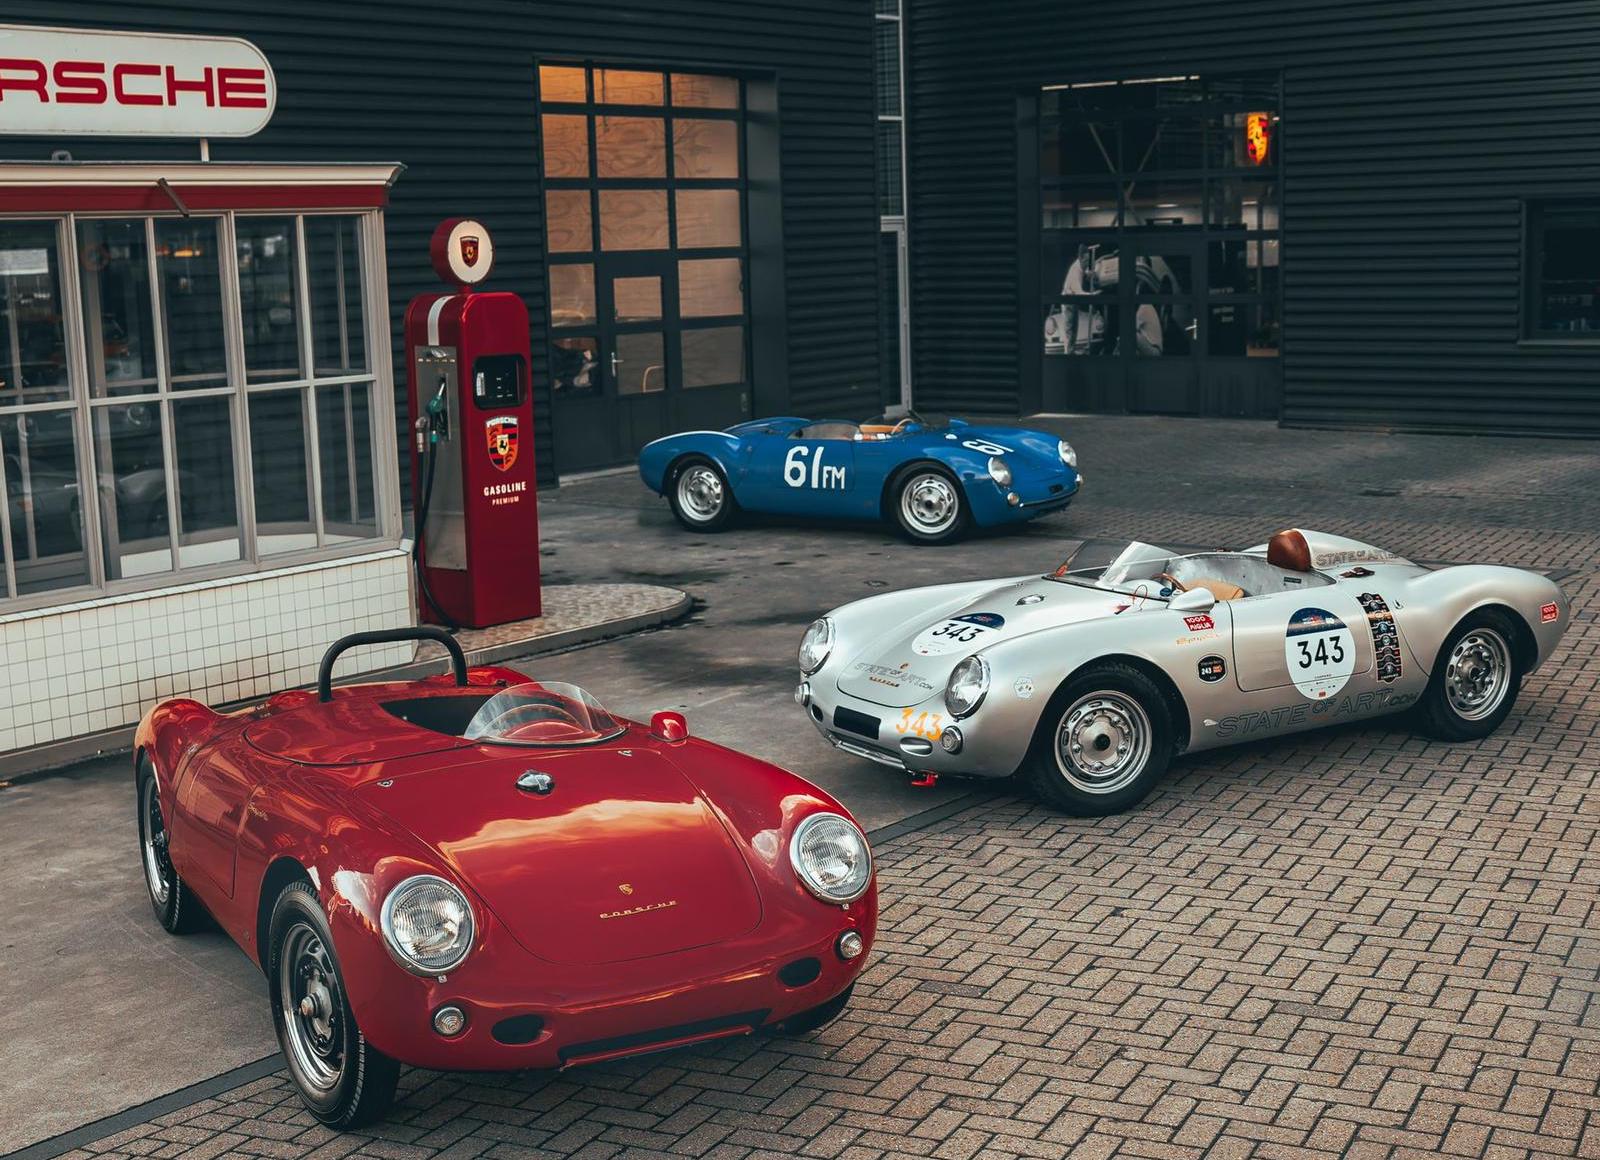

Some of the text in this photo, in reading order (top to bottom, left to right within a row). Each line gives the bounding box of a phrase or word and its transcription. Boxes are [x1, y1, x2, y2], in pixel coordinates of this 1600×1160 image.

[962, 439, 1014, 455] 61
[484, 482, 526, 496] GASOLINE
[492, 496, 519, 505] PREMIUM
[1315, 551, 1356, 566] STATE
[932, 623, 985, 642] 343
[1297, 635, 1344, 669] 343
[896, 706, 944, 742] 343
[1215, 703, 1311, 738] STATE
[1311, 697, 1336, 714] OF
[599, 900, 678, 919] PORSCHE
